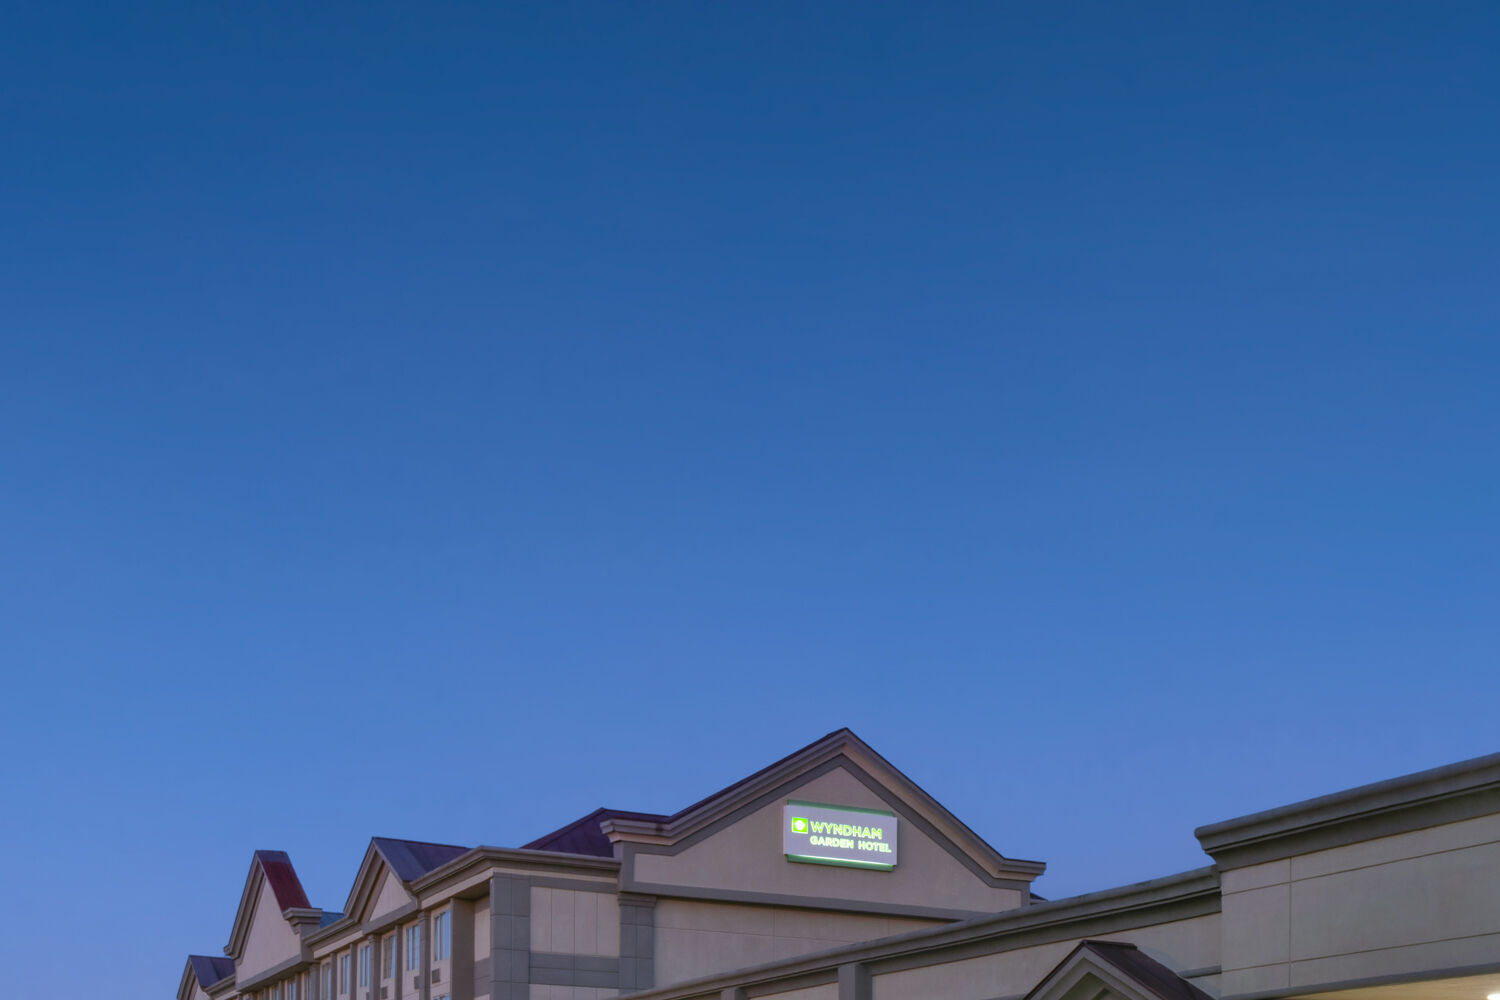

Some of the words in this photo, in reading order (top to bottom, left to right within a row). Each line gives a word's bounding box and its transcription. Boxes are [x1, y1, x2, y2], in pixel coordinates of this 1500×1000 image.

[810, 821, 882, 840] WYNDHAM
[810, 835, 854, 849] GARDEN
[858, 840, 892, 853] HOTEL
